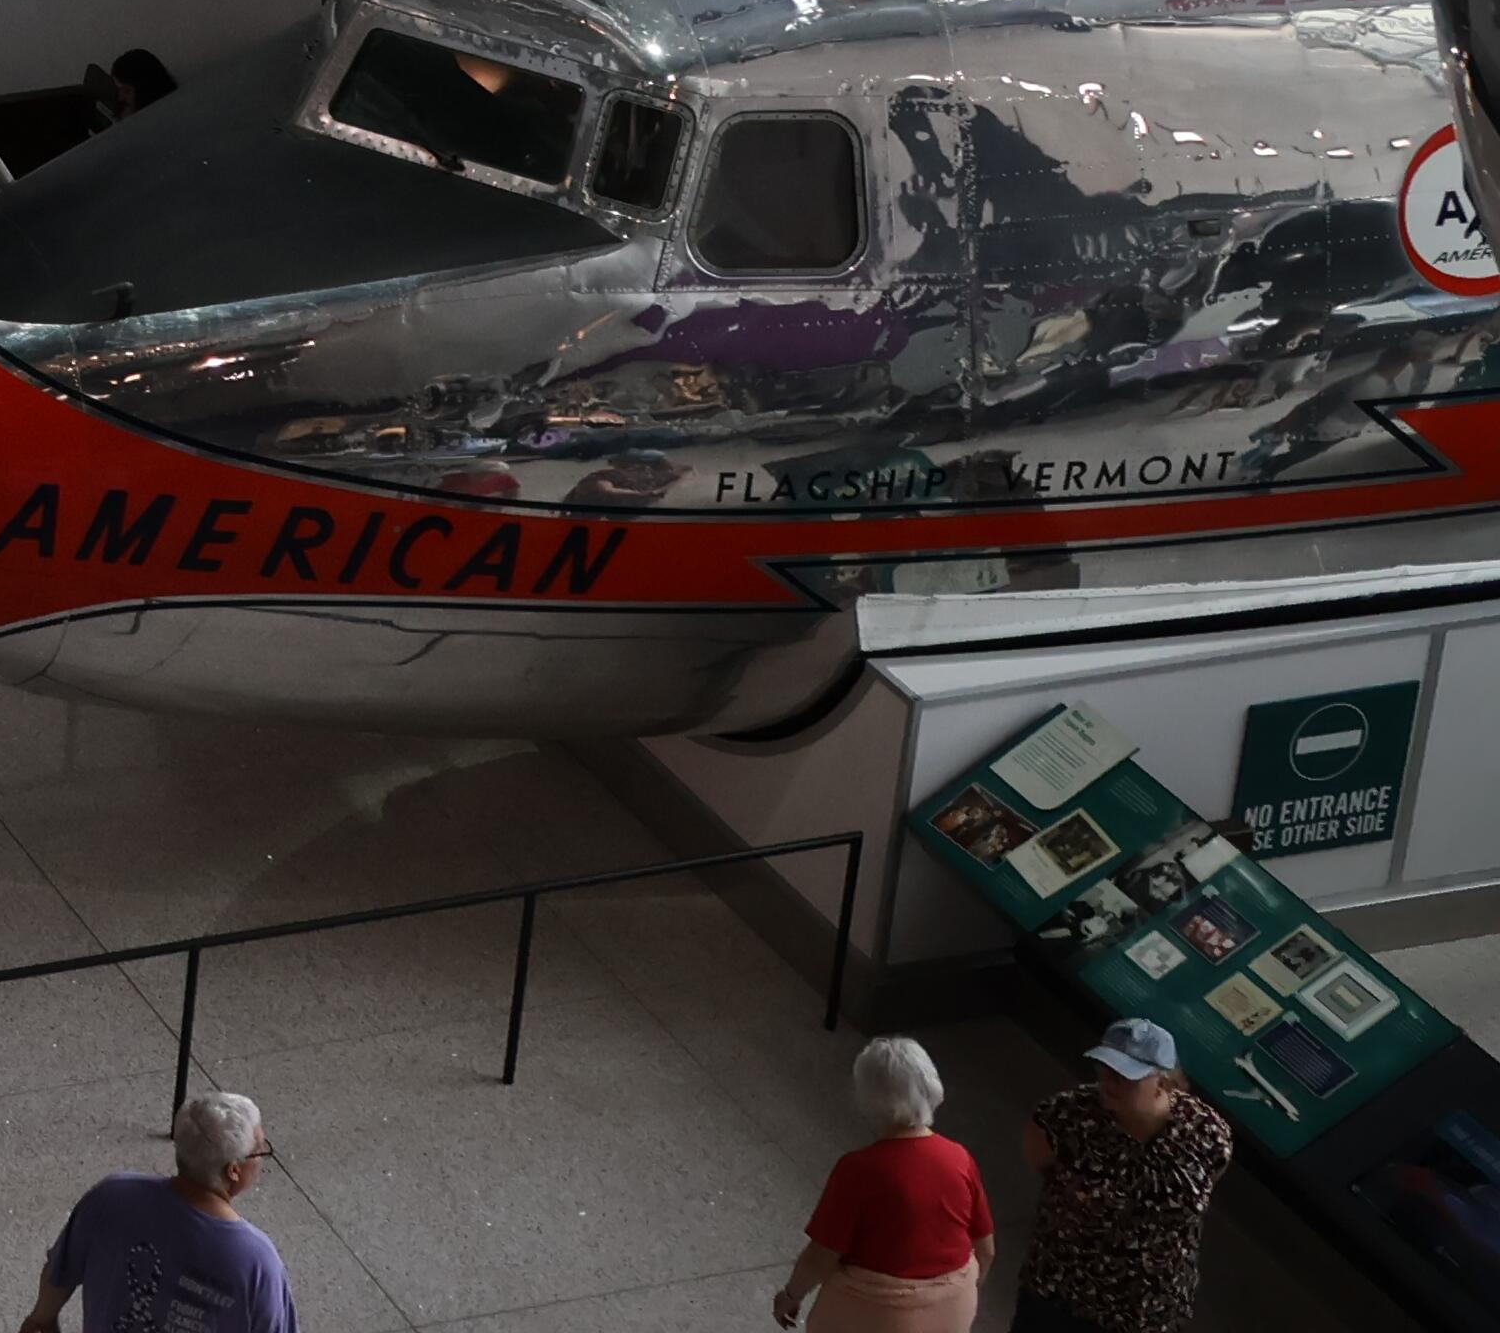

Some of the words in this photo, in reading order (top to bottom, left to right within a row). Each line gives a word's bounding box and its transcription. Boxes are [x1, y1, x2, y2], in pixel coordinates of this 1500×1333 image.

[714, 467, 949, 505] FLAGSHIP
[1002, 450, 1238, 495] VERMONT
[1243, 804, 1273, 830] NO
[1278, 785, 1392, 826] ENTRANCE
[1252, 824, 1276, 853] SE
[1280, 818, 1340, 848] OTHER
[1343, 810, 1389, 837] SIDE
